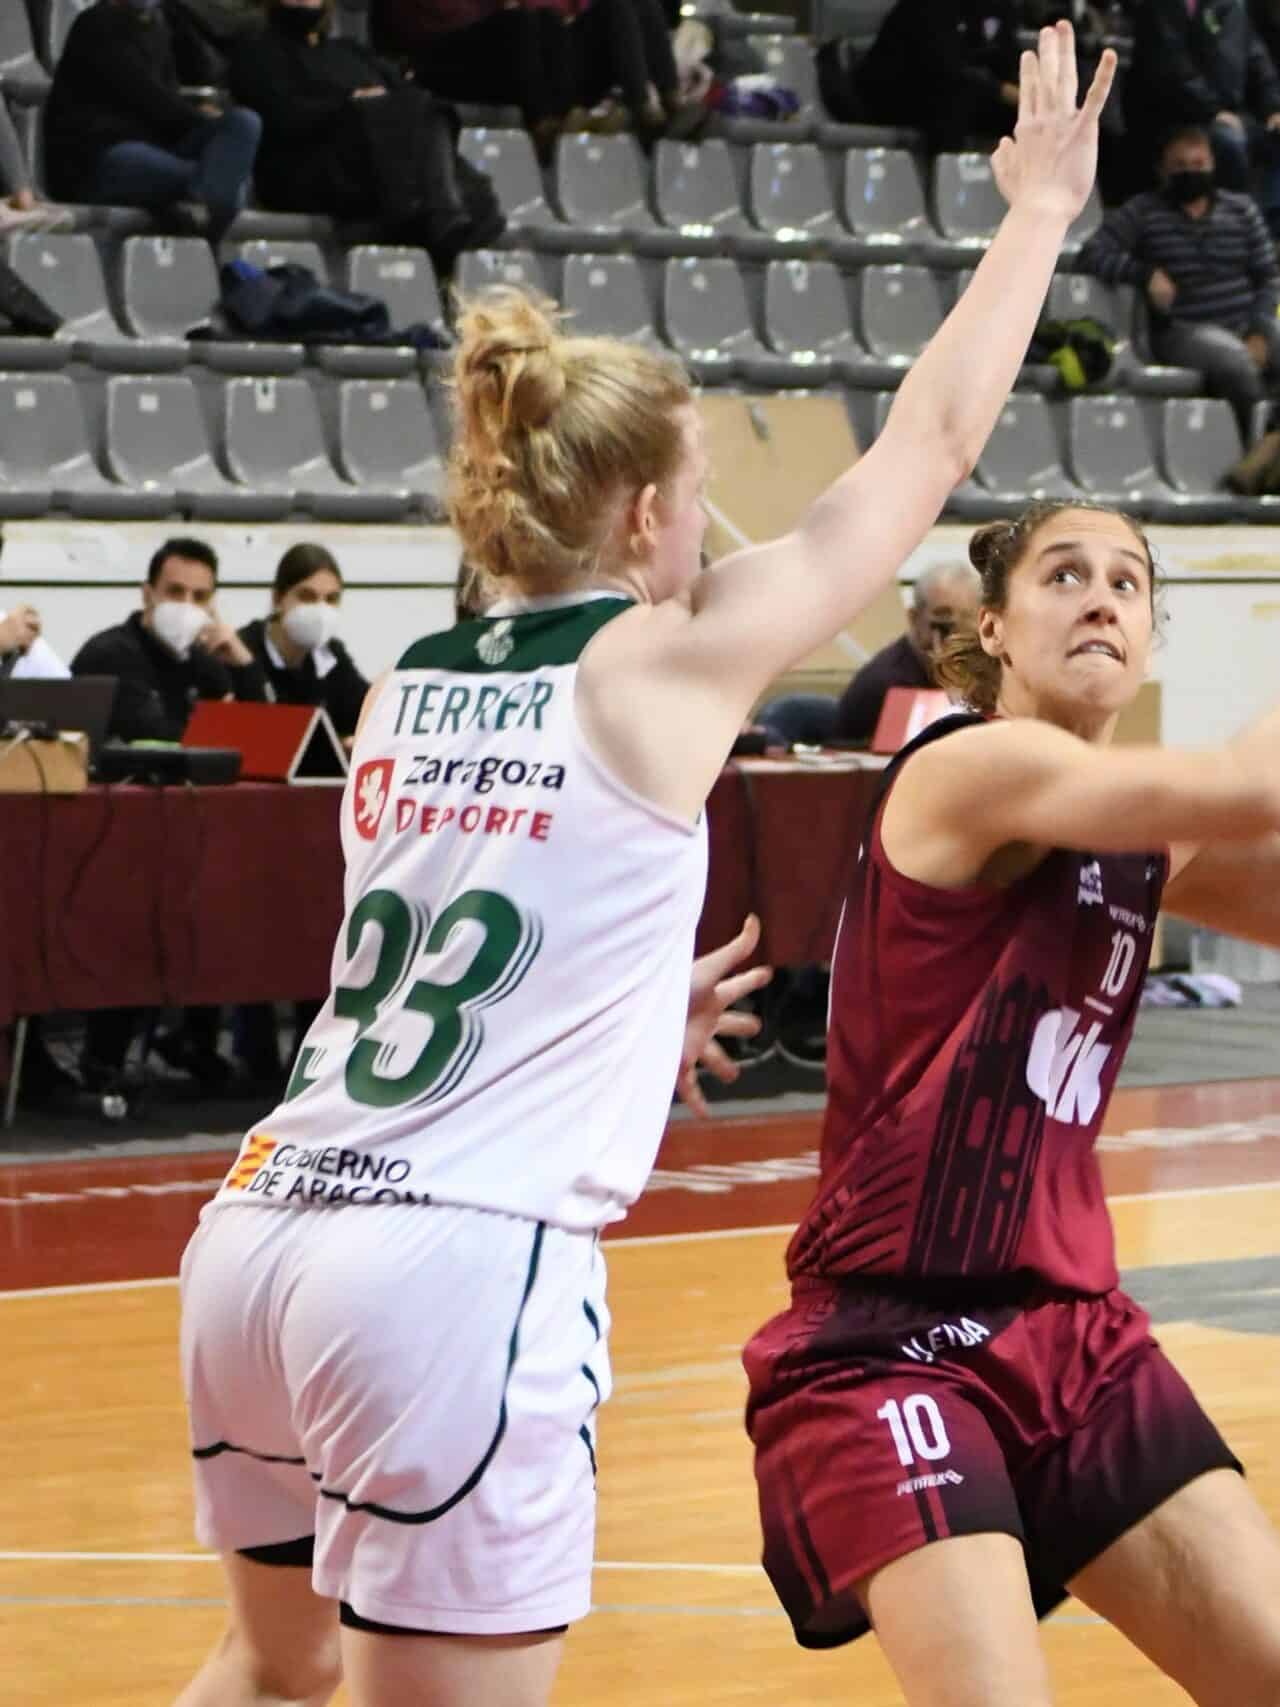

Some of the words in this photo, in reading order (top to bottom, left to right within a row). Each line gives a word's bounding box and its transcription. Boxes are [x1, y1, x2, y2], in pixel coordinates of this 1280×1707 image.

[394, 680, 554, 736] TERRER
[402, 755, 567, 794] Zaragoza
[395, 797, 554, 842] DEPORTE
[1099, 929, 1137, 998] 10
[249, 1170, 285, 1196] DE
[876, 1392, 952, 1468] 10
